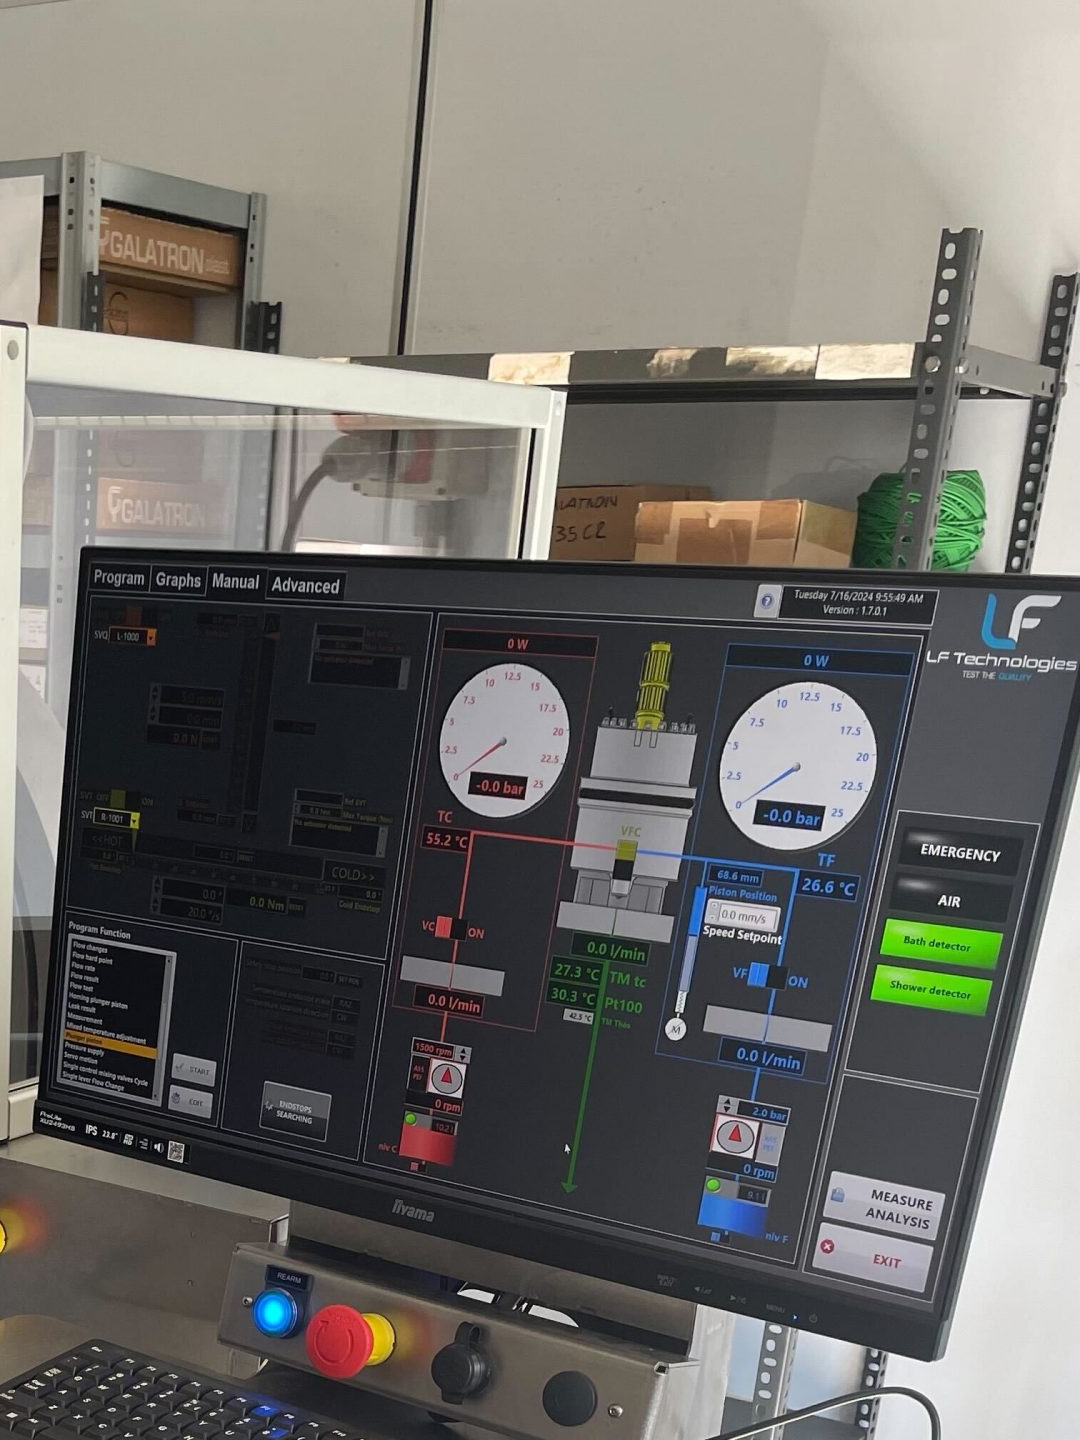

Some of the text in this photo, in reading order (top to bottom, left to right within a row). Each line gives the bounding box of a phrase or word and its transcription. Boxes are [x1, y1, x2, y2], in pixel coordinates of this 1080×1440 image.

[110, 230, 205, 275] GALATRON
[122, 499, 206, 527] GALATRON
[94, 568, 145, 588] Program
[156, 571, 201, 591] Graphs
[212, 572, 260, 590] Manual
[271, 575, 340, 596] Advanced
[794, 589, 924, 604] Tuesday 7/16/2024 9:55:49 AM
[823, 604, 888, 617] Version 1.7.0.1
[981, 592, 1062, 650] LF
[94, 629, 108, 641] SVQ
[116, 631, 140, 643] L-1000
[507, 638, 529, 650] 0 W
[803, 654, 829, 668] 0 W
[926, 650, 1078, 673] LF Technologies
[485, 678, 495, 688] 10
[504, 671, 522, 681] 12.5
[962, 670, 1032, 682] TEST THE QUALITY
[530, 682, 541, 691] 15
[463, 695, 476, 705] 7.5
[799, 691, 820, 702] 12.5
[539, 703, 557, 713] 17.5
[776, 699, 788, 709] 10
[830, 702, 842, 712] 15
[449, 717, 455, 726] 5
[749, 717, 765, 728] 7.5
[552, 727, 564, 736] 20
[840, 726, 862, 736] 17.5
[444, 745, 458, 754] 2.5
[732, 741, 739, 750] 5
[540, 754, 560, 764] 22.5
[856, 752, 869, 762] 20
[453, 773, 459, 781] 0
[726, 771, 742, 781] 2.5
[475, 779, 524, 795] -0.0 bar
[533, 779, 544, 789] 25
[840, 780, 863, 791] 22.5
[735, 801, 742, 810] 0
[831, 807, 844, 817] 25
[80, 810, 93, 820] SVT
[100, 812, 124, 824] R-1001
[437, 809, 453, 824] TC
[763, 809, 820, 827] -0.0 bar
[621, 825, 641, 838] VFC
[426, 831, 469, 849] 55.2 °C
[818, 852, 836, 867] TF
[920, 843, 1002, 863] EMERGENCY
[717, 869, 759, 884] 68.6 mm
[708, 885, 778, 903] Piston Position
[801, 877, 856, 897] 26.6 °C
[249, 896, 285, 911] 0.0 Nm
[937, 894, 961, 908] AIR
[187, 906, 207, 919] 20.0
[721, 908, 767, 926] 0.0 mm/s
[68, 920, 131, 940] Program Function
[422, 920, 436, 932] VC
[468, 927, 486, 940] ON
[702, 925, 783, 945] Speed Setpoint
[72, 941, 108, 954] Flow changes
[903, 935, 972, 953] Bath detector
[72, 951, 113, 966] Flow hard point
[587, 941, 646, 962] 0.0 l/min
[71, 961, 96, 972] Flow rate
[554, 963, 600, 981] 27.3 °C
[733, 967, 748, 980] VF
[70, 971, 99, 983] Flow result
[610, 971, 646, 988] TM tc
[788, 975, 809, 989] ON
[69, 981, 93, 992] Flow test
[889, 980, 972, 1001] Shower detector
[69, 991, 129, 1010] Homing plunger piston
[428, 993, 481, 1014] 0.0 l/min
[551, 987, 596, 1006] 30.3 °C
[68, 1002, 97, 1014] Leak result
[604, 996, 643, 1014] Pt100
[67, 1011, 103, 1026] Measurement
[66, 1021, 147, 1045] Mixed temperature adjustment
[64, 1041, 105, 1057] Pressure supply
[415, 1042, 453, 1058] 1500 rpm
[63, 1051, 98, 1065] Servo motion
[736, 1046, 801, 1071] 0.0 l/min
[63, 1060, 149, 1088] Single control mixing valves Cycle
[189, 1065, 210, 1076] START
[62, 1070, 125, 1092] Single lever Flow Change
[188, 1098, 203, 1108] EDIT
[279, 1099, 313, 1114] ENDSTOPS
[434, 1098, 462, 1113] 0 rpm
[276, 1110, 313, 1125] SEARCHING
[753, 1106, 787, 1121] 2.0 bar
[85, 1123, 98, 1137] IPS
[391, 1145, 397, 1153] C
[743, 1163, 776, 1180] 0 rpm
[871, 1189, 934, 1211] MEASURE
[865, 1207, 930, 1230] ANALYSIS
[765, 1232, 789, 1244] niv F
[873, 1254, 902, 1269] EXIT
[276, 1271, 302, 1284] REARM
